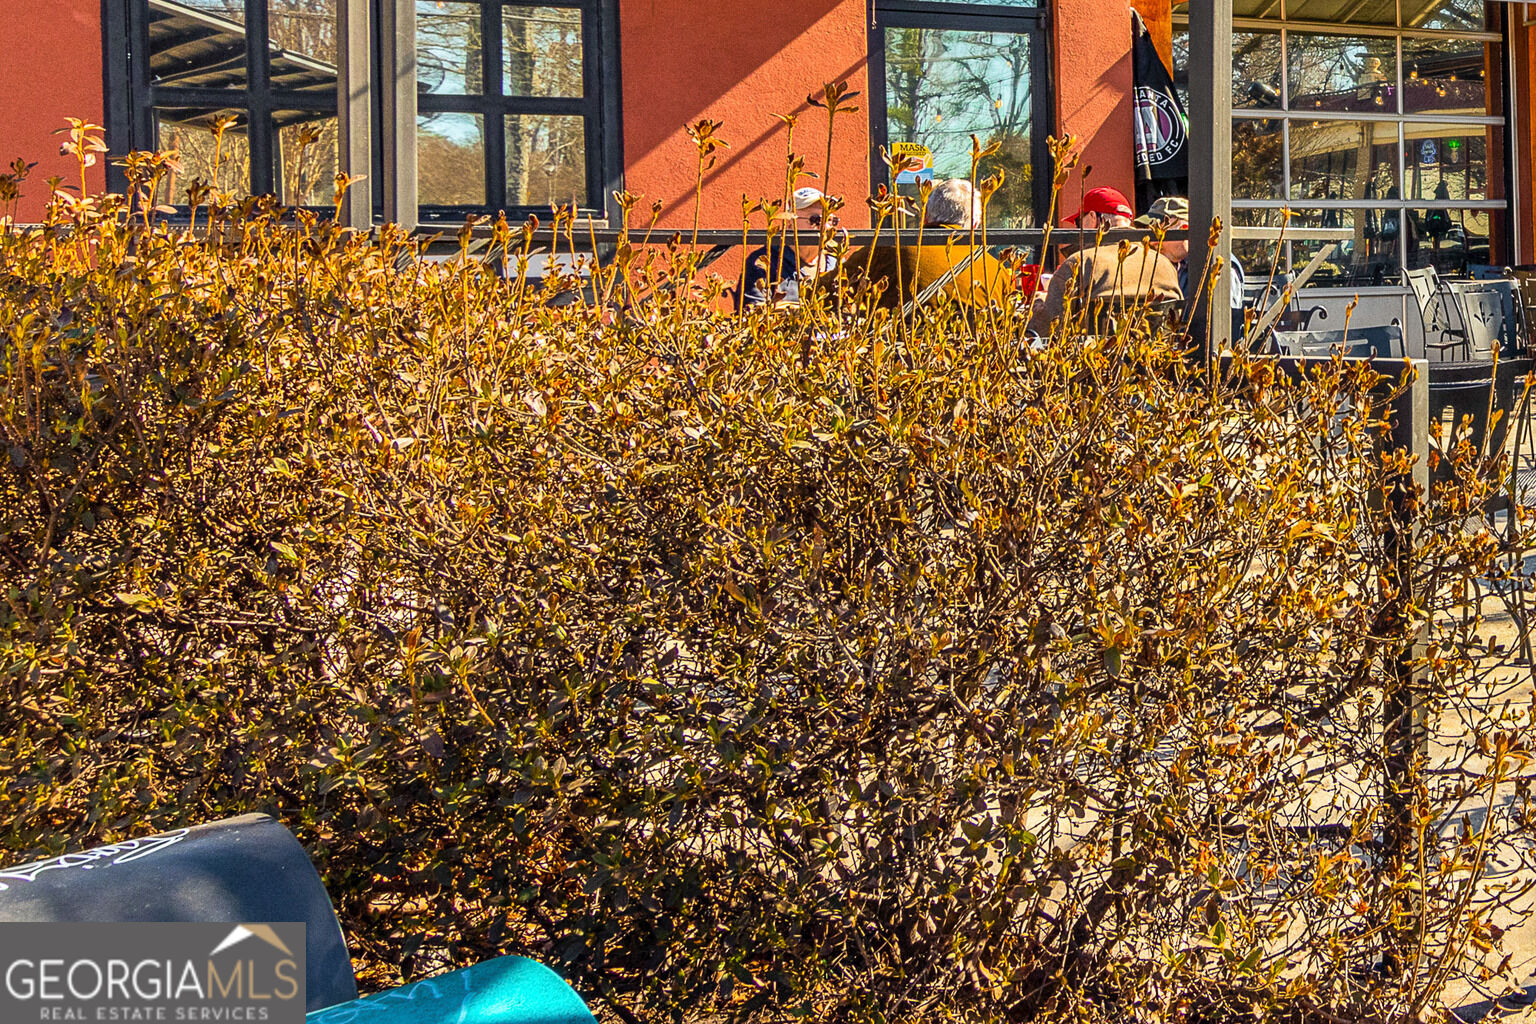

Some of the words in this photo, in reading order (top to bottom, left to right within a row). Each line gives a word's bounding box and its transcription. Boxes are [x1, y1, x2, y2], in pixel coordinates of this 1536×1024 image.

[1139, 89, 1168, 108] ANTA
[900, 144, 926, 152] MASK
[1165, 139, 1179, 154] FC
